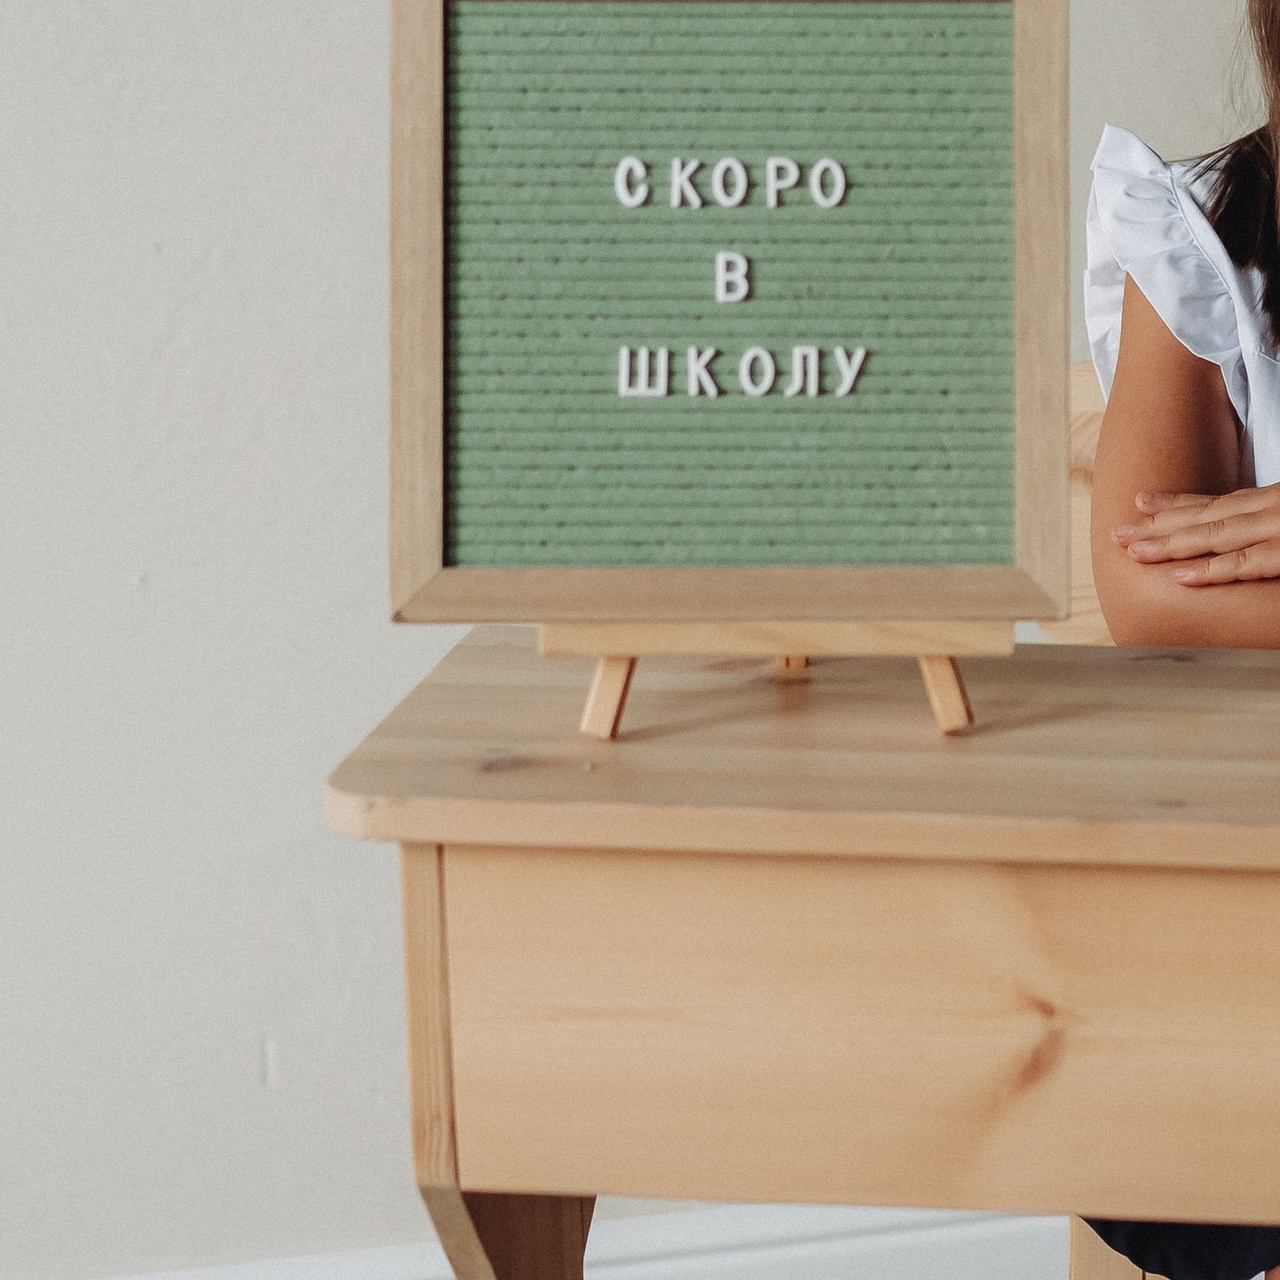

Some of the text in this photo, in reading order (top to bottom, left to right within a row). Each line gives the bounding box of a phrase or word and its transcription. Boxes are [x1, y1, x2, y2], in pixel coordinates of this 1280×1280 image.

[614, 155, 846, 209] СКОРО
[714, 250, 749, 304] В
[617, 344, 867, 398] ШКОЛУ
